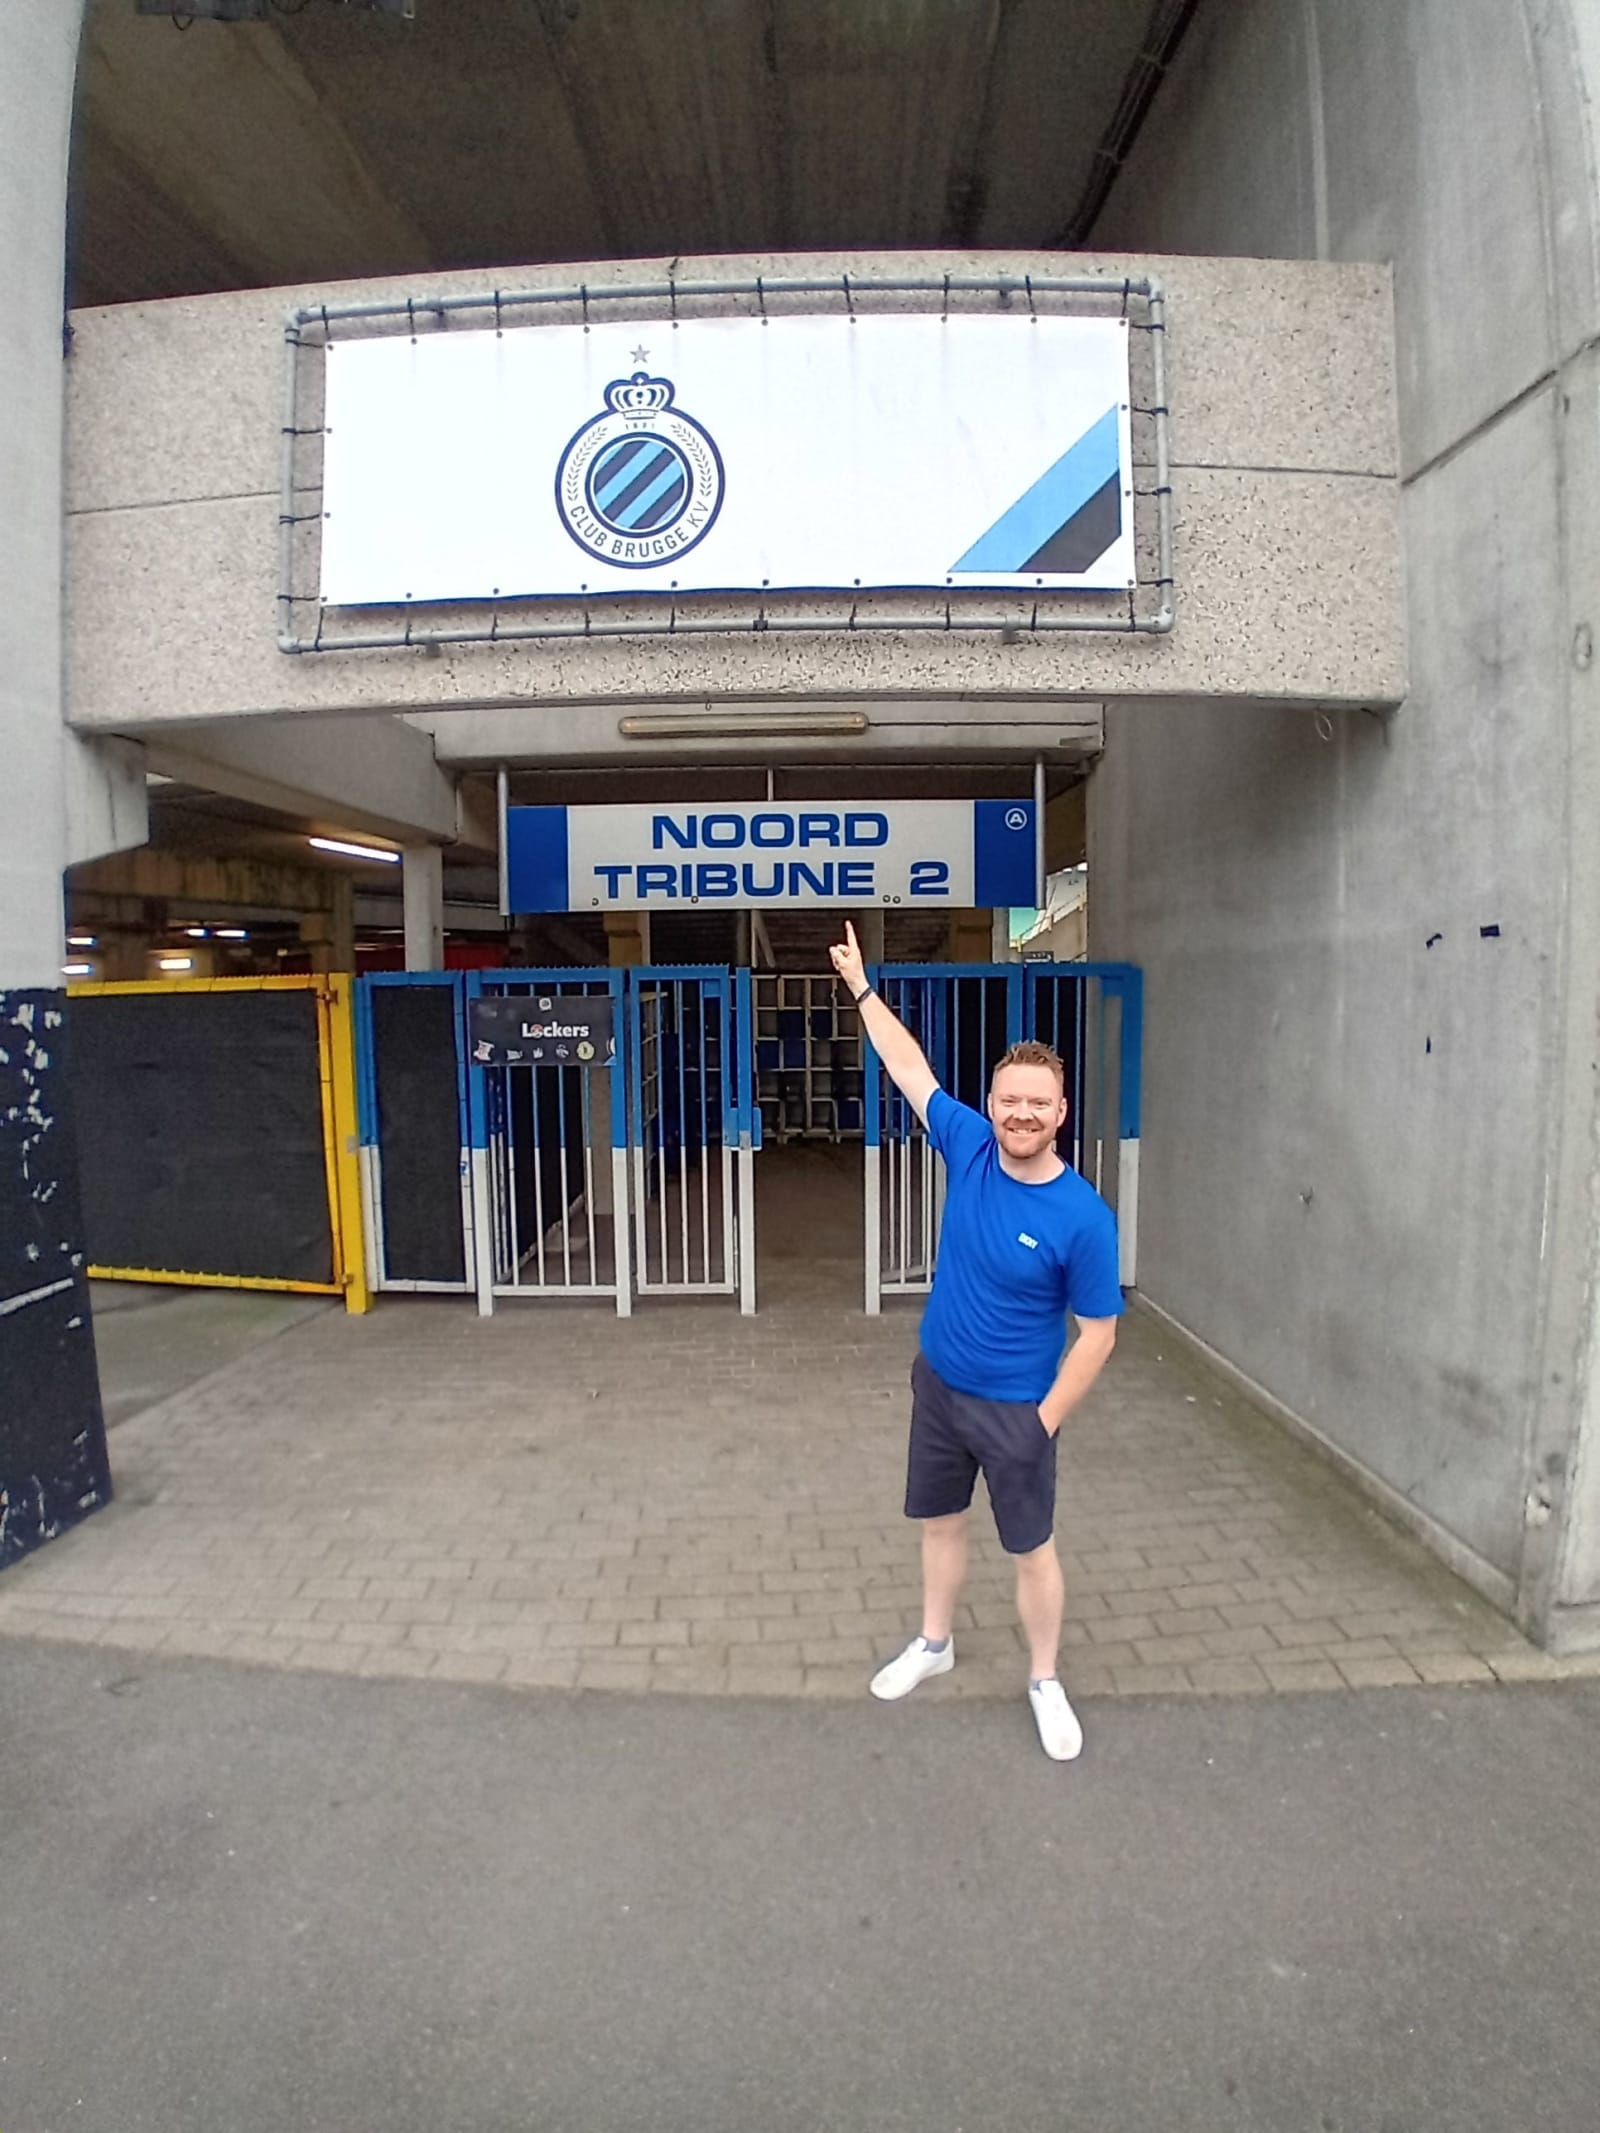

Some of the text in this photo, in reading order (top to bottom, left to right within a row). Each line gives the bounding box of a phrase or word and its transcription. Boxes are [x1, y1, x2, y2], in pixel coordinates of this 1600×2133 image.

[570, 500, 709, 558] CLUB BRUGGE KV
[652, 812, 889, 849] NOORD
[594, 861, 949, 899] TRIBUNE 2
[522, 1021, 589, 1038] Lockers
